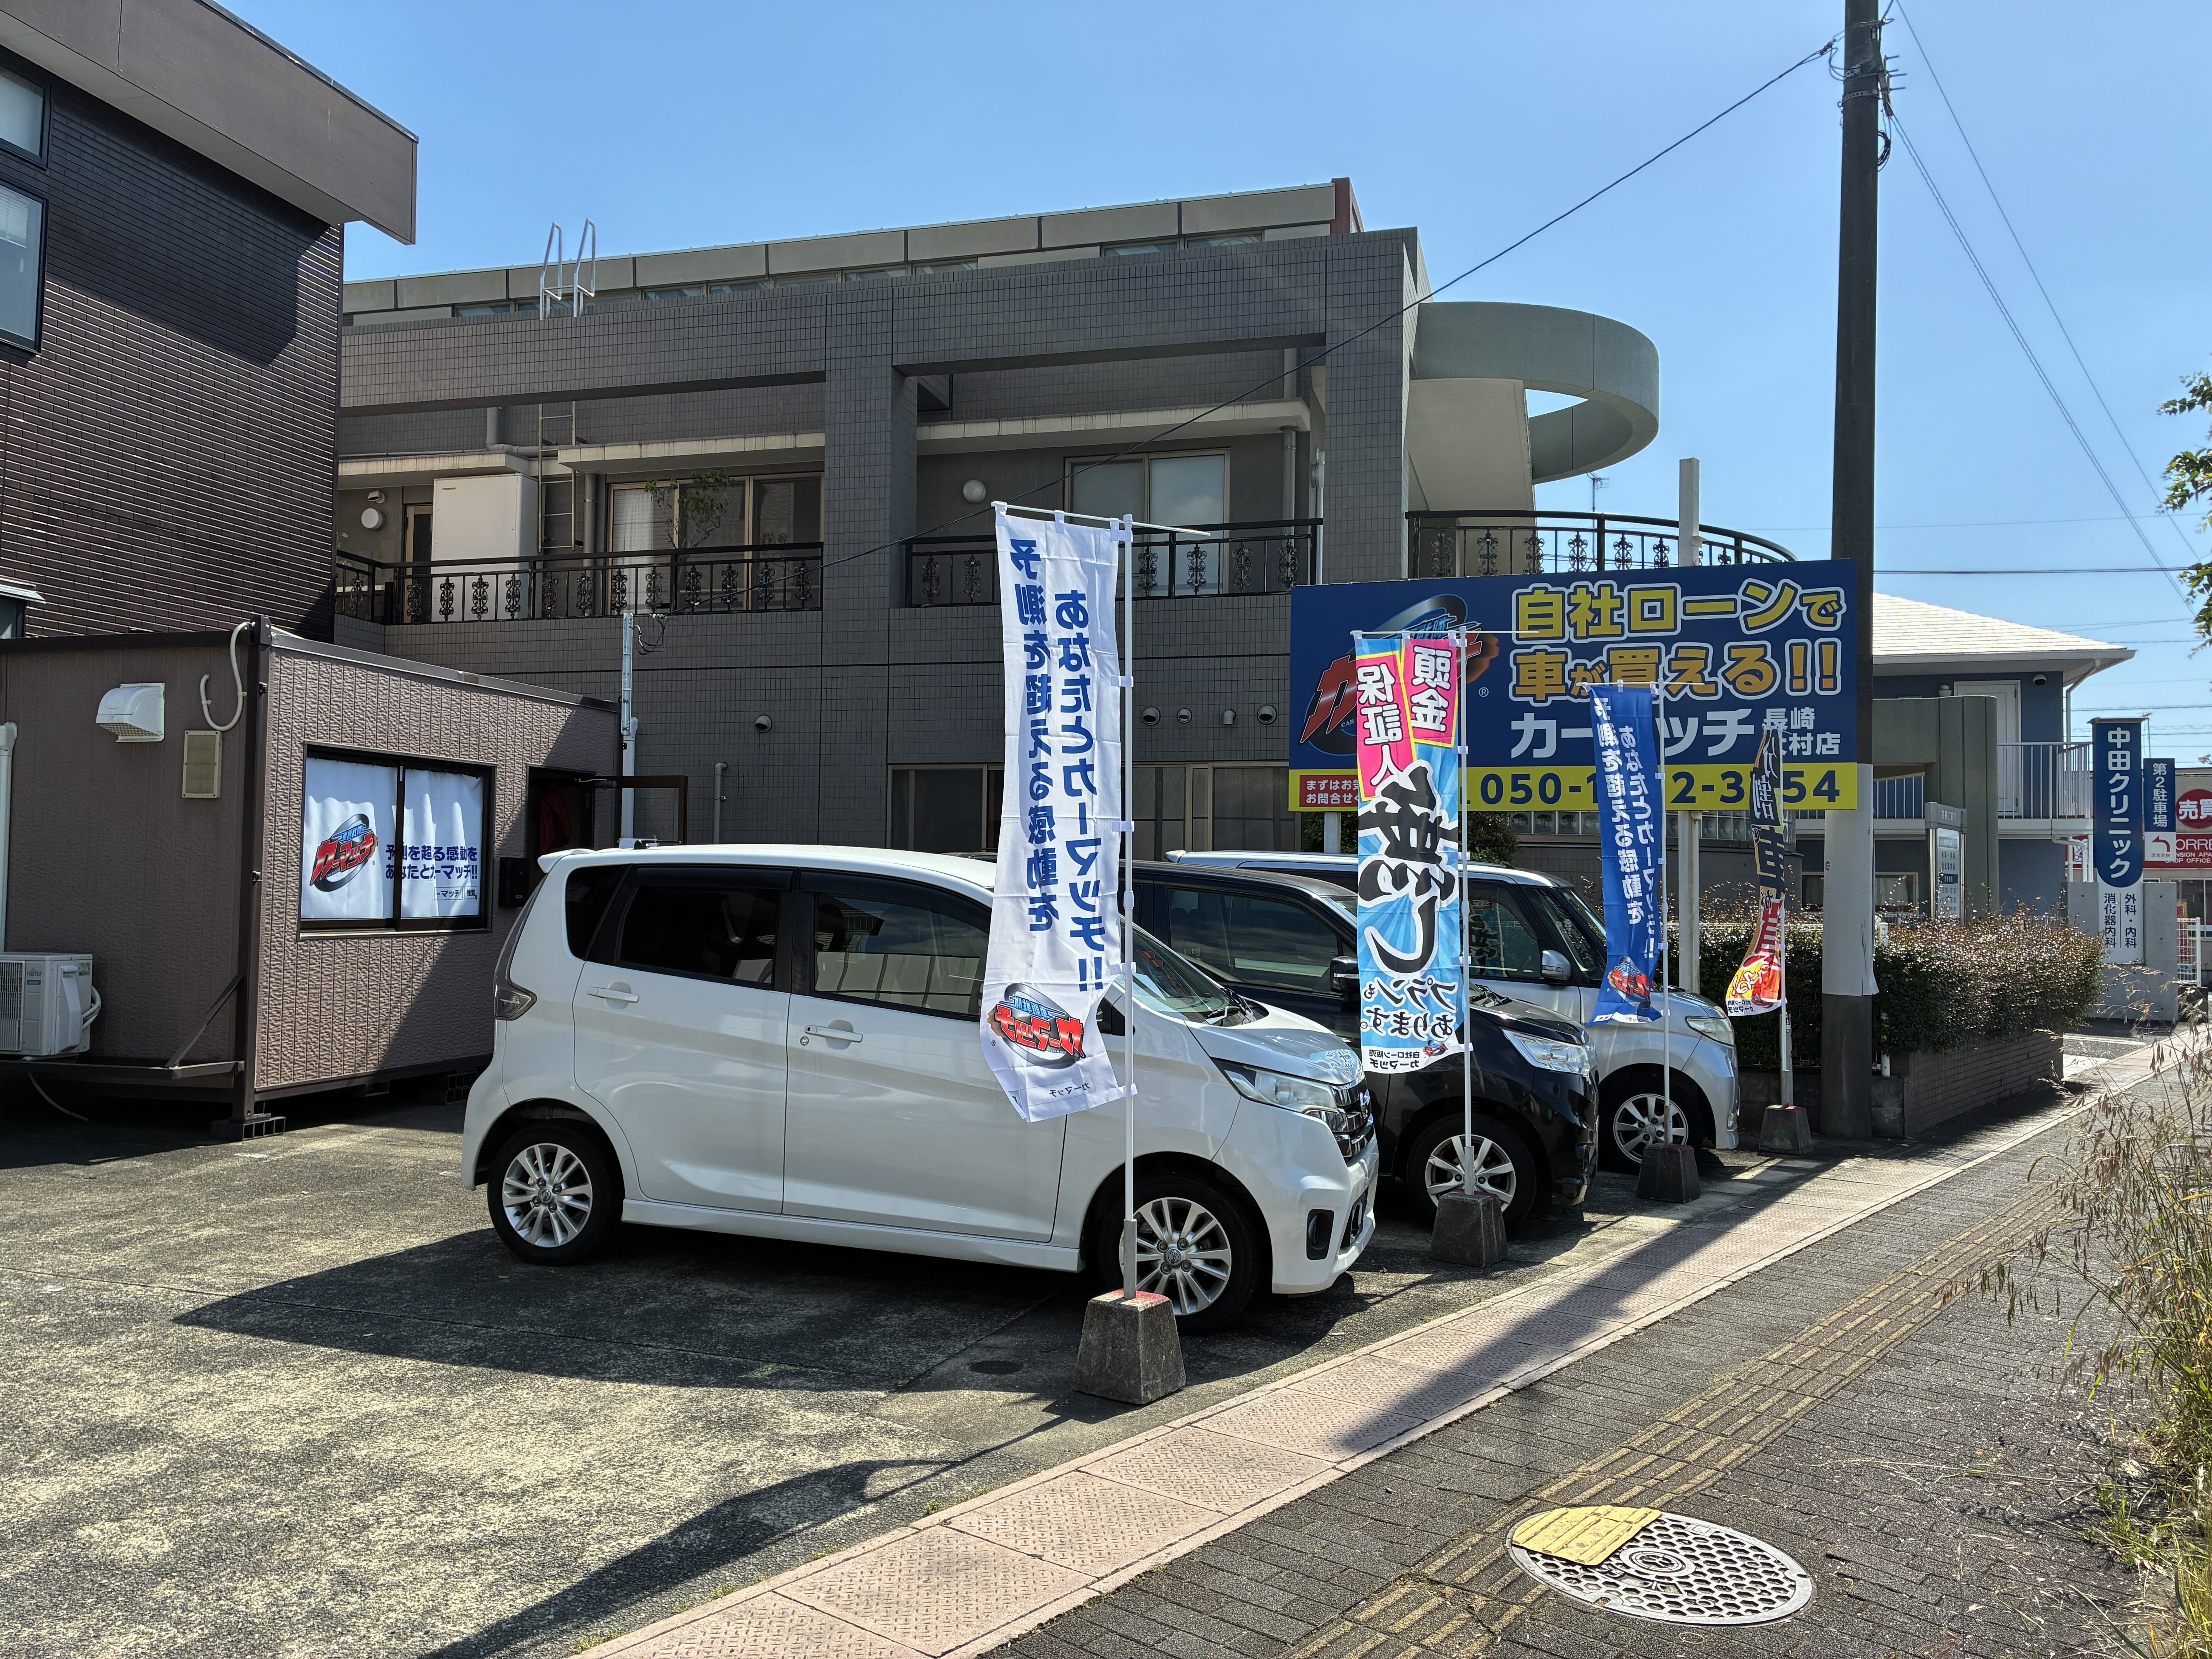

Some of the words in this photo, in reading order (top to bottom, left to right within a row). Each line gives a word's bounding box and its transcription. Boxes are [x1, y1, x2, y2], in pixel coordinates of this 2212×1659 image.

[1513, 580, 1846, 643] 自社ローンで
[1511, 638, 1842, 703] 車が買える!!
[1511, 708, 1754, 759] カーッチ
[1764, 707, 1815, 730] 長崎
[1480, 770, 1840, 805] 050-12-354
[2108, 727, 2131, 878] 中田クリニック
[2153, 763, 2168, 827] 第2駐車場
[2104, 893, 2116, 948] 消化器内科
[2125, 893, 2136, 948] 外科・内科
